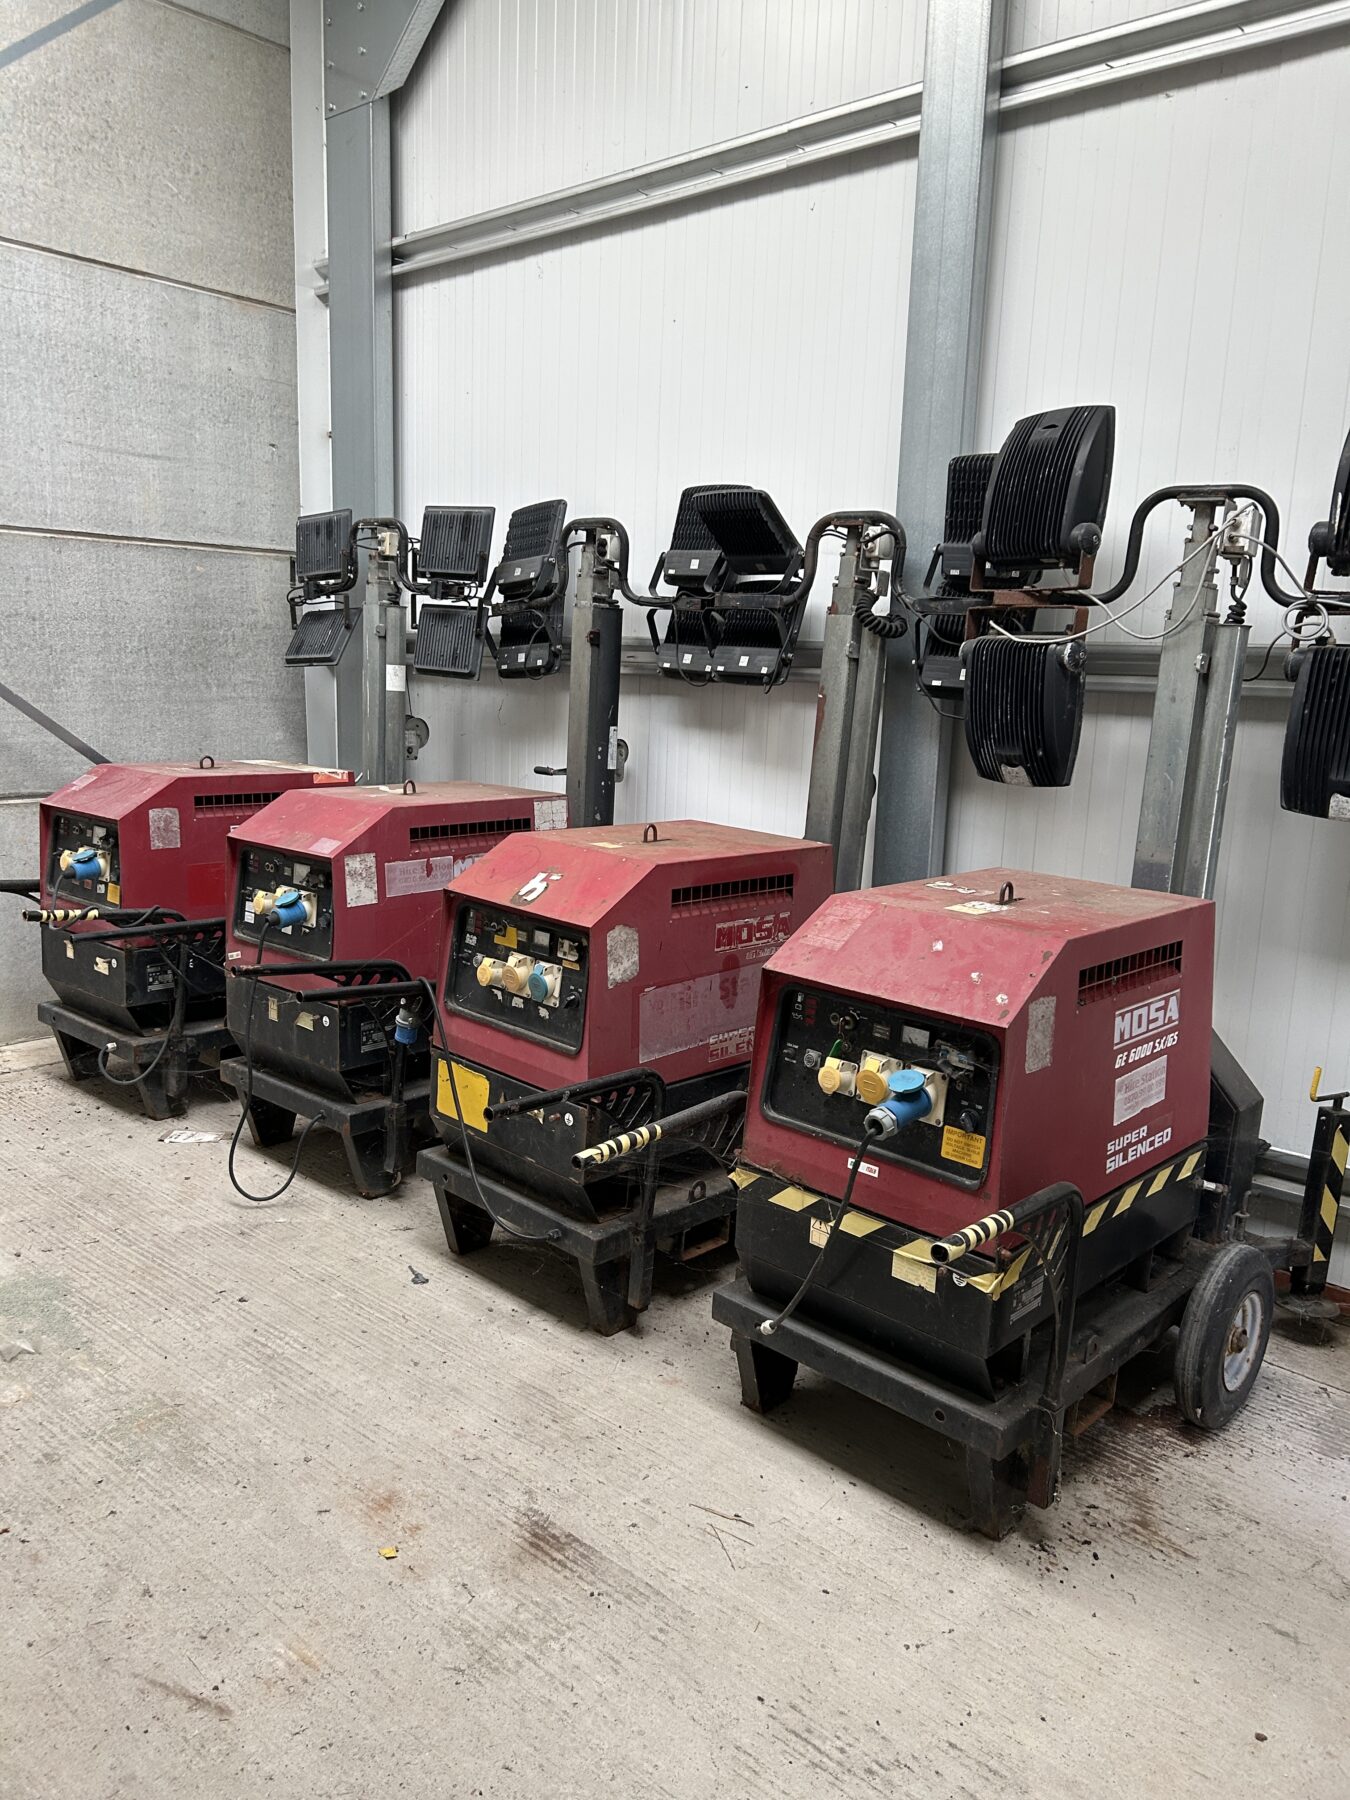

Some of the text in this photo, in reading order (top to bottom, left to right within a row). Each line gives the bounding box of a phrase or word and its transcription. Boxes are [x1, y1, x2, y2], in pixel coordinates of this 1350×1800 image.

[715, 914, 790, 950] MOSA
[1114, 995, 1179, 1045] MOSA
[1128, 1041, 1154, 1064] 6000
[945, 1127, 983, 1144] IMPORTANT
[1105, 1126, 1172, 1175] SILENCED
[1106, 1124, 1148, 1156] SUPER
